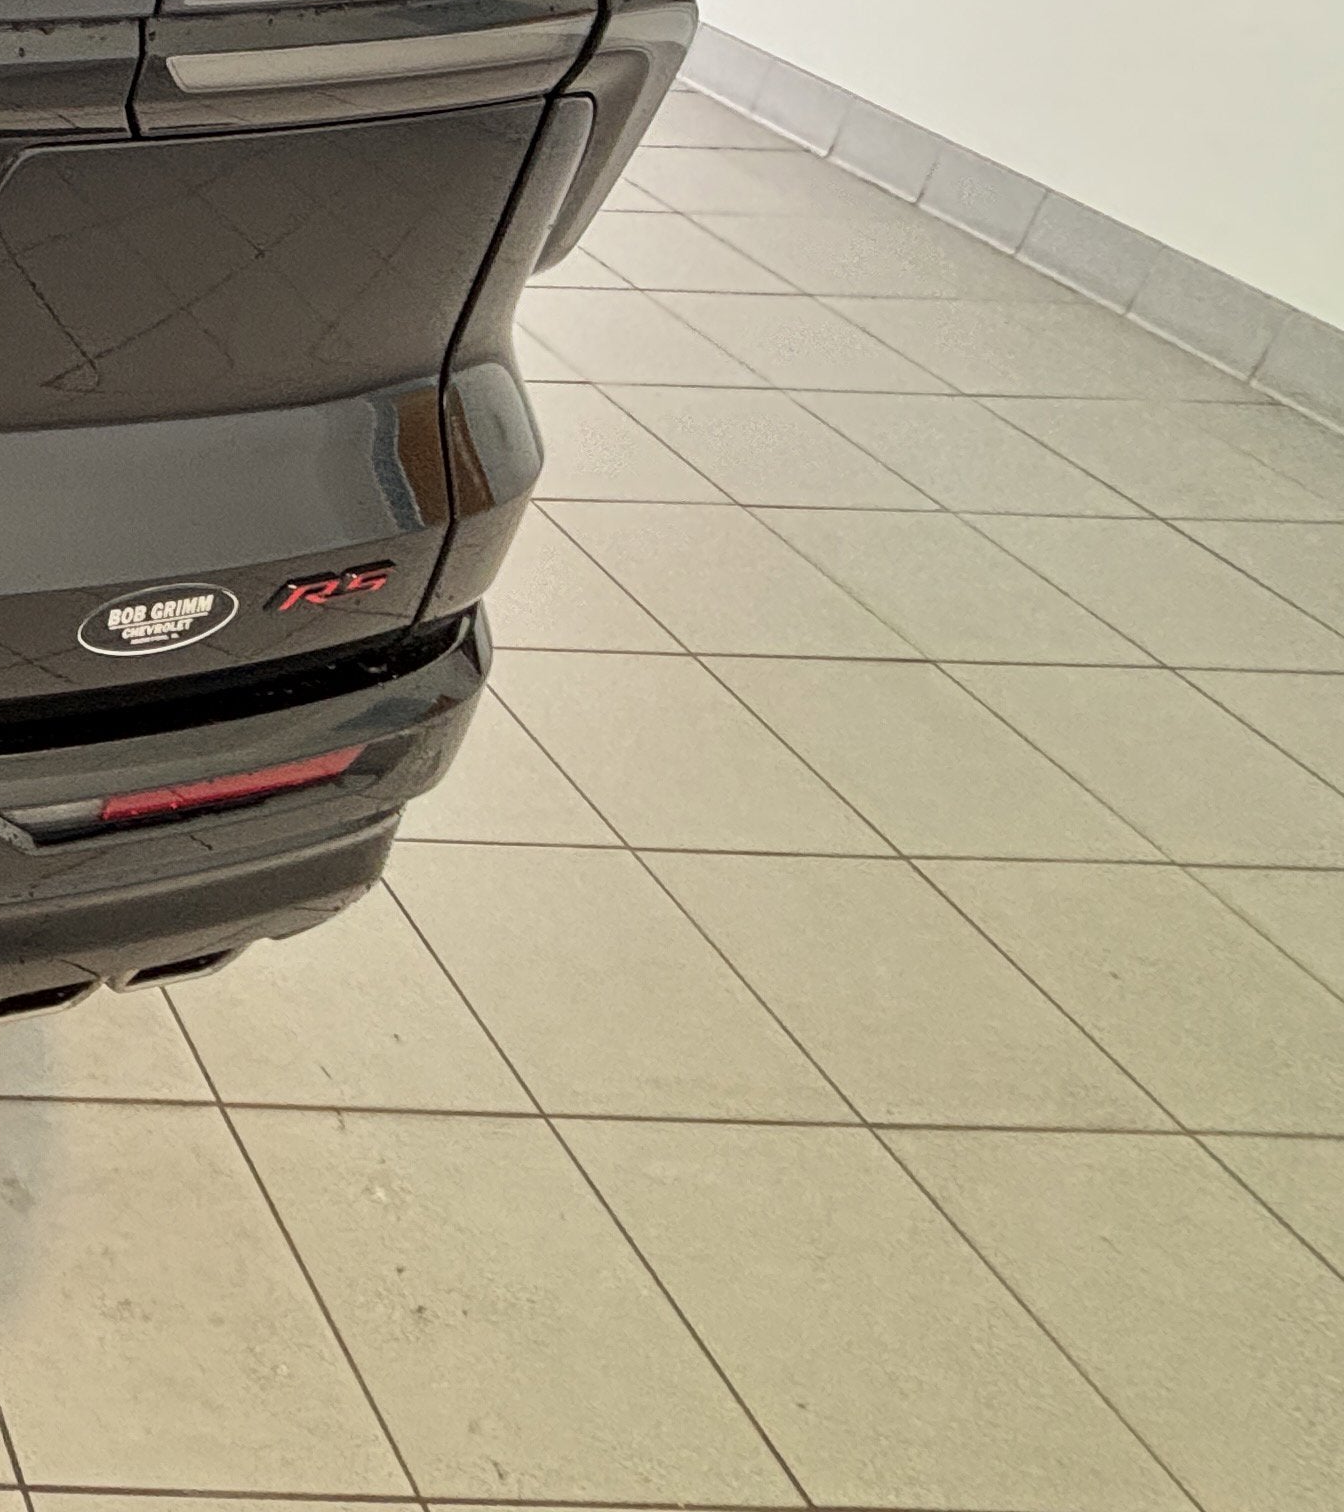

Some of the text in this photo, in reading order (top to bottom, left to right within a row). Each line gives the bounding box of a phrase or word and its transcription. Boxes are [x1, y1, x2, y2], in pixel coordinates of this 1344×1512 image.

[265, 559, 397, 611] RS
[107, 593, 215, 628] BOB GRIMM
[121, 618, 195, 640] CHEVROLET
